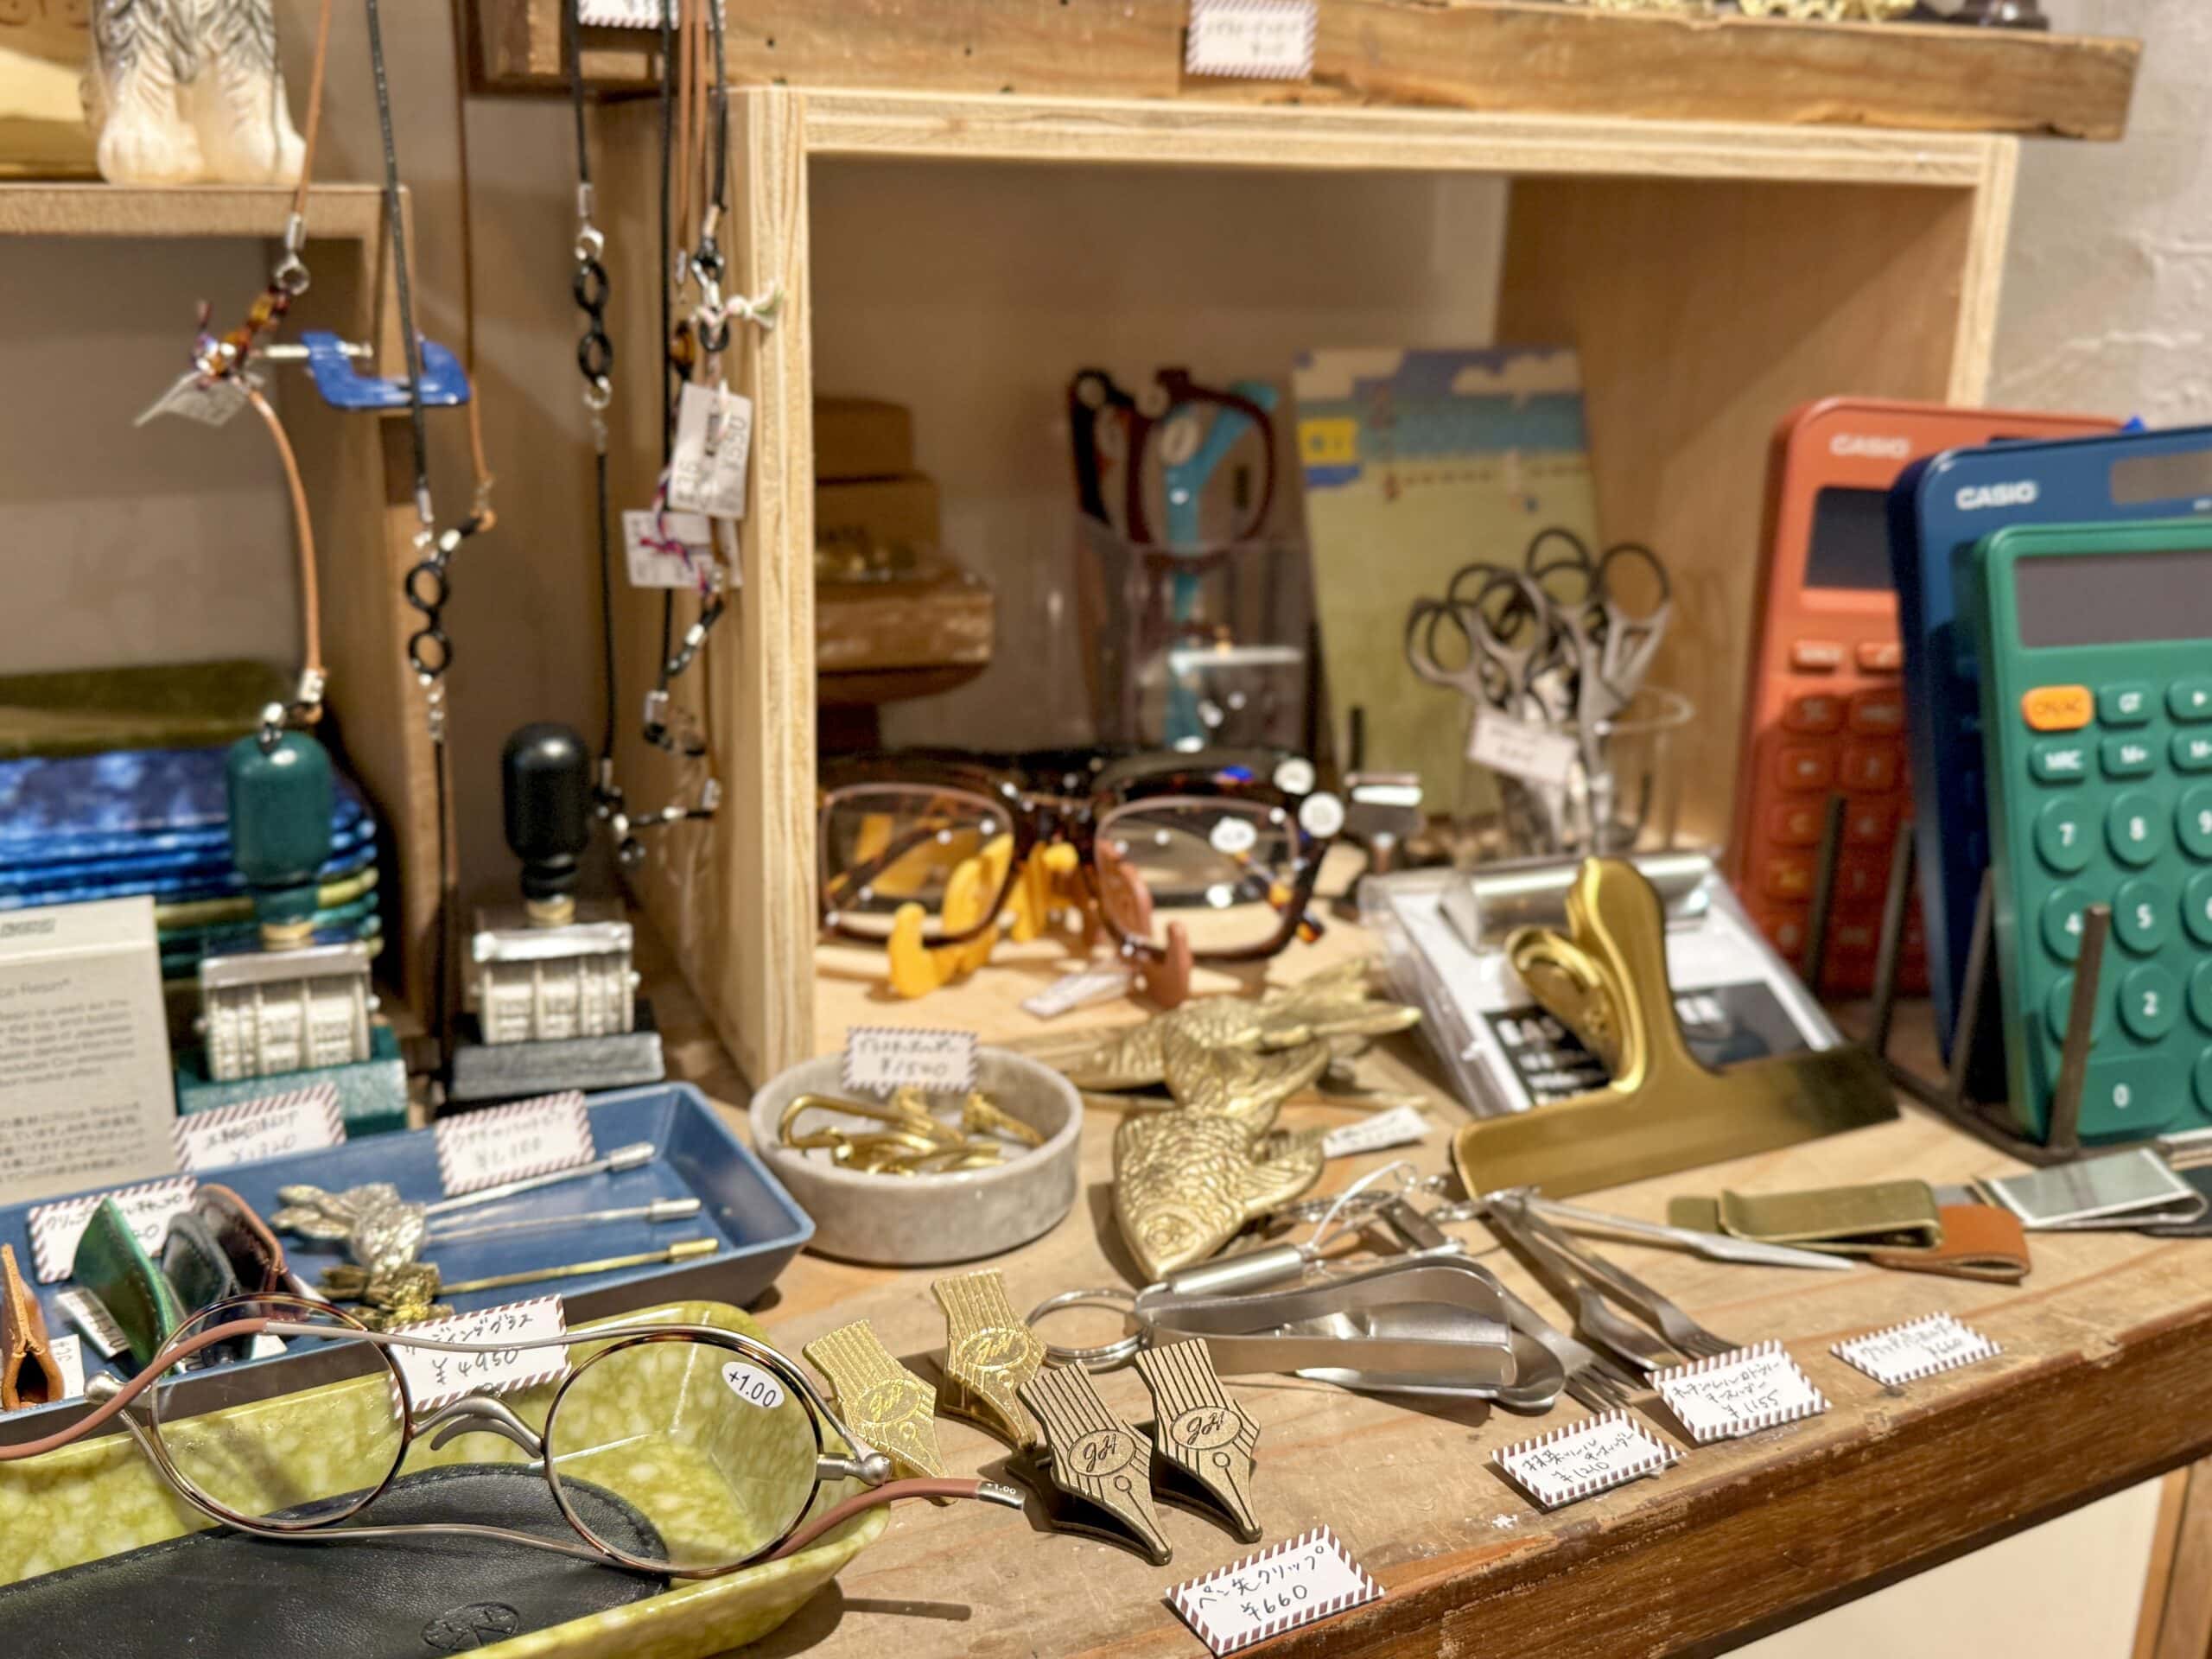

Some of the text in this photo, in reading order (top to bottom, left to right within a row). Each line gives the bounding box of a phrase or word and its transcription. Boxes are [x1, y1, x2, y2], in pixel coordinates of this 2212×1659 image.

[1830, 434, 1910, 458] CASIO
[1955, 480, 2039, 510] CASIO
[2058, 822, 2076, 847] 7
[2129, 816, 2146, 842] 8
[2064, 912, 2085, 936] 4
[2135, 903, 2153, 930] 5
[2142, 990, 2158, 1017] 2
[2112, 1082, 2131, 1109] 0
[432, 1348, 518, 1384] ¥4950
[728, 1370, 777, 1408] +1.00
[1198, 1546, 1325, 1610] ペン先クリップ
[1240, 1584, 1308, 1622] ¥660
